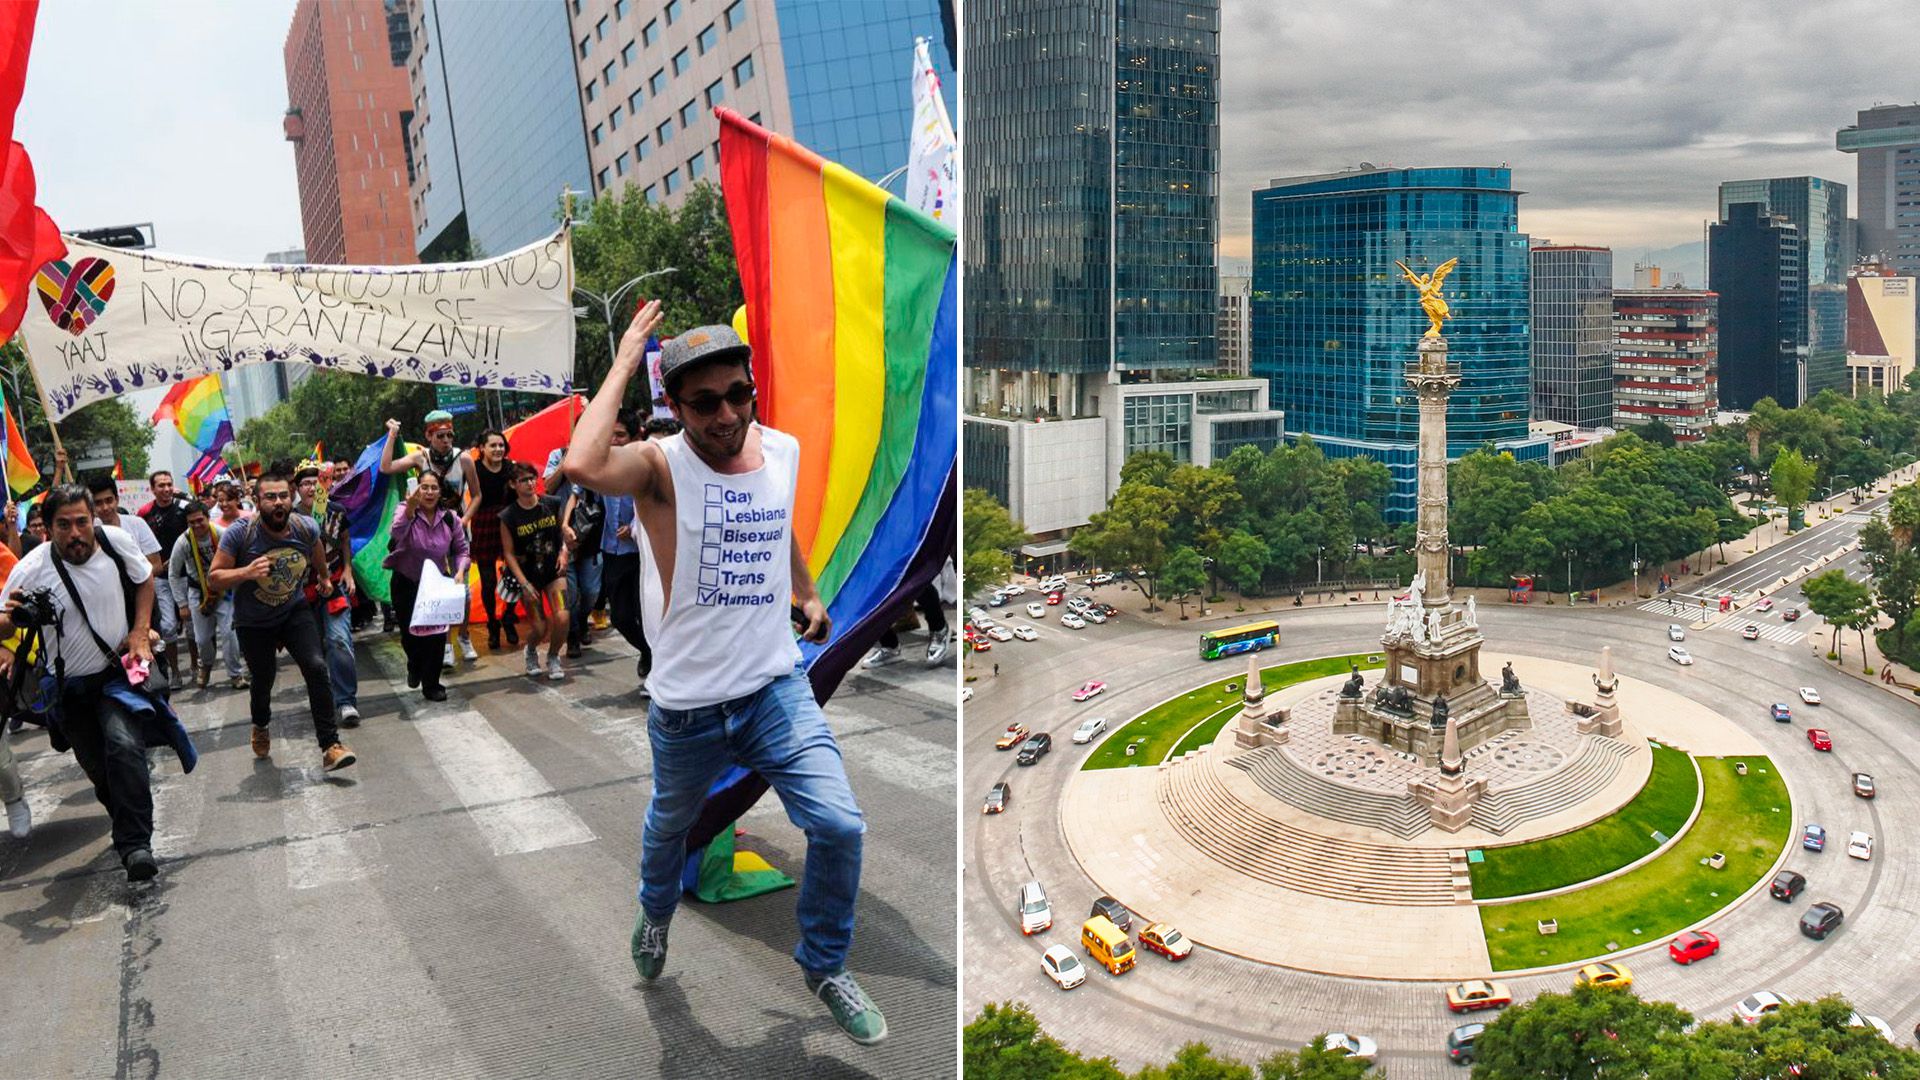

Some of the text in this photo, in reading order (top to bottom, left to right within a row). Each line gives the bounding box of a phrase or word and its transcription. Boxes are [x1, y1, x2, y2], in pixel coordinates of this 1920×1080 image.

[141, 277, 206, 325] NO
[220, 271, 268, 310] SE
[434, 298, 476, 325] SE
[55, 331, 108, 370] YAAJ
[724, 490, 753, 505] Gay
[725, 508, 786, 523] Lesbiana
[723, 527, 783, 543] Bisexual
[722, 549, 772, 563] Hetero
[721, 571, 765, 586] Trans
